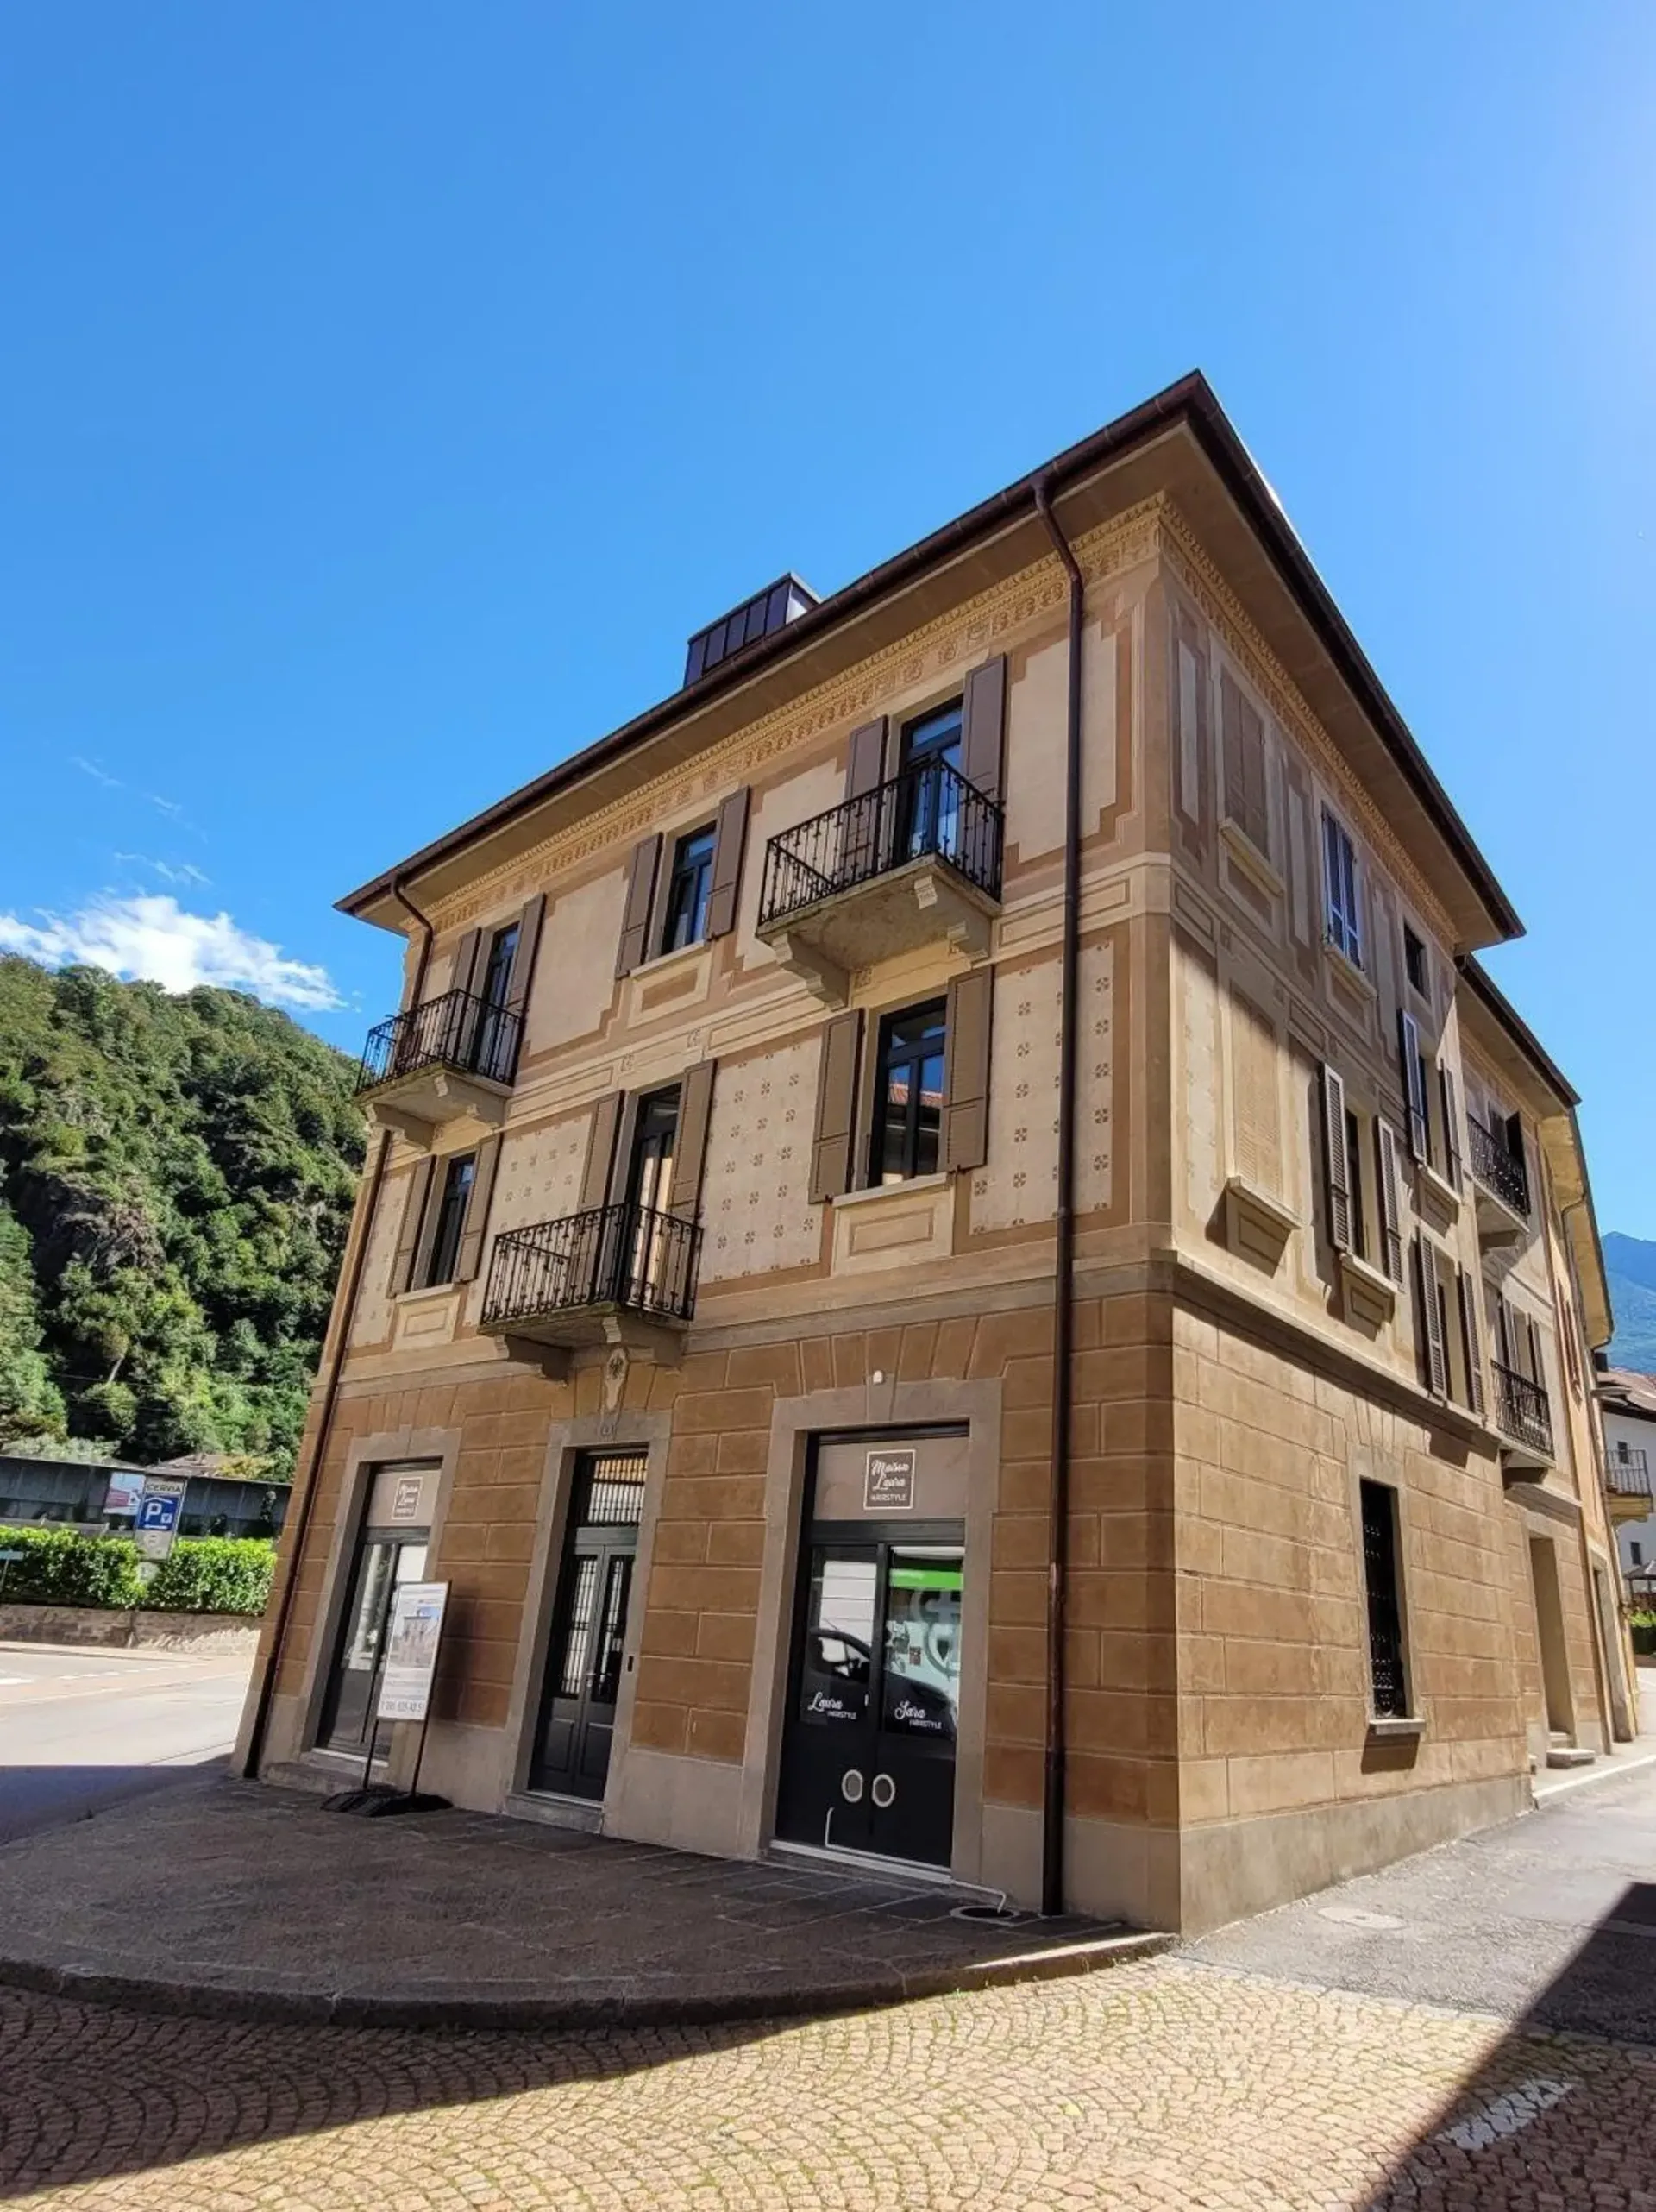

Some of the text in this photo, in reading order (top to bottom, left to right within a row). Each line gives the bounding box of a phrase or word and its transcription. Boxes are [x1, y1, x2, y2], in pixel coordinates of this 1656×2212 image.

[870, 1493, 907, 1502] HAIRSTYLE
[144, 1502, 162, 1522] P
[807, 1691, 844, 1712] Laura
[894, 1700, 926, 1720] Sara
